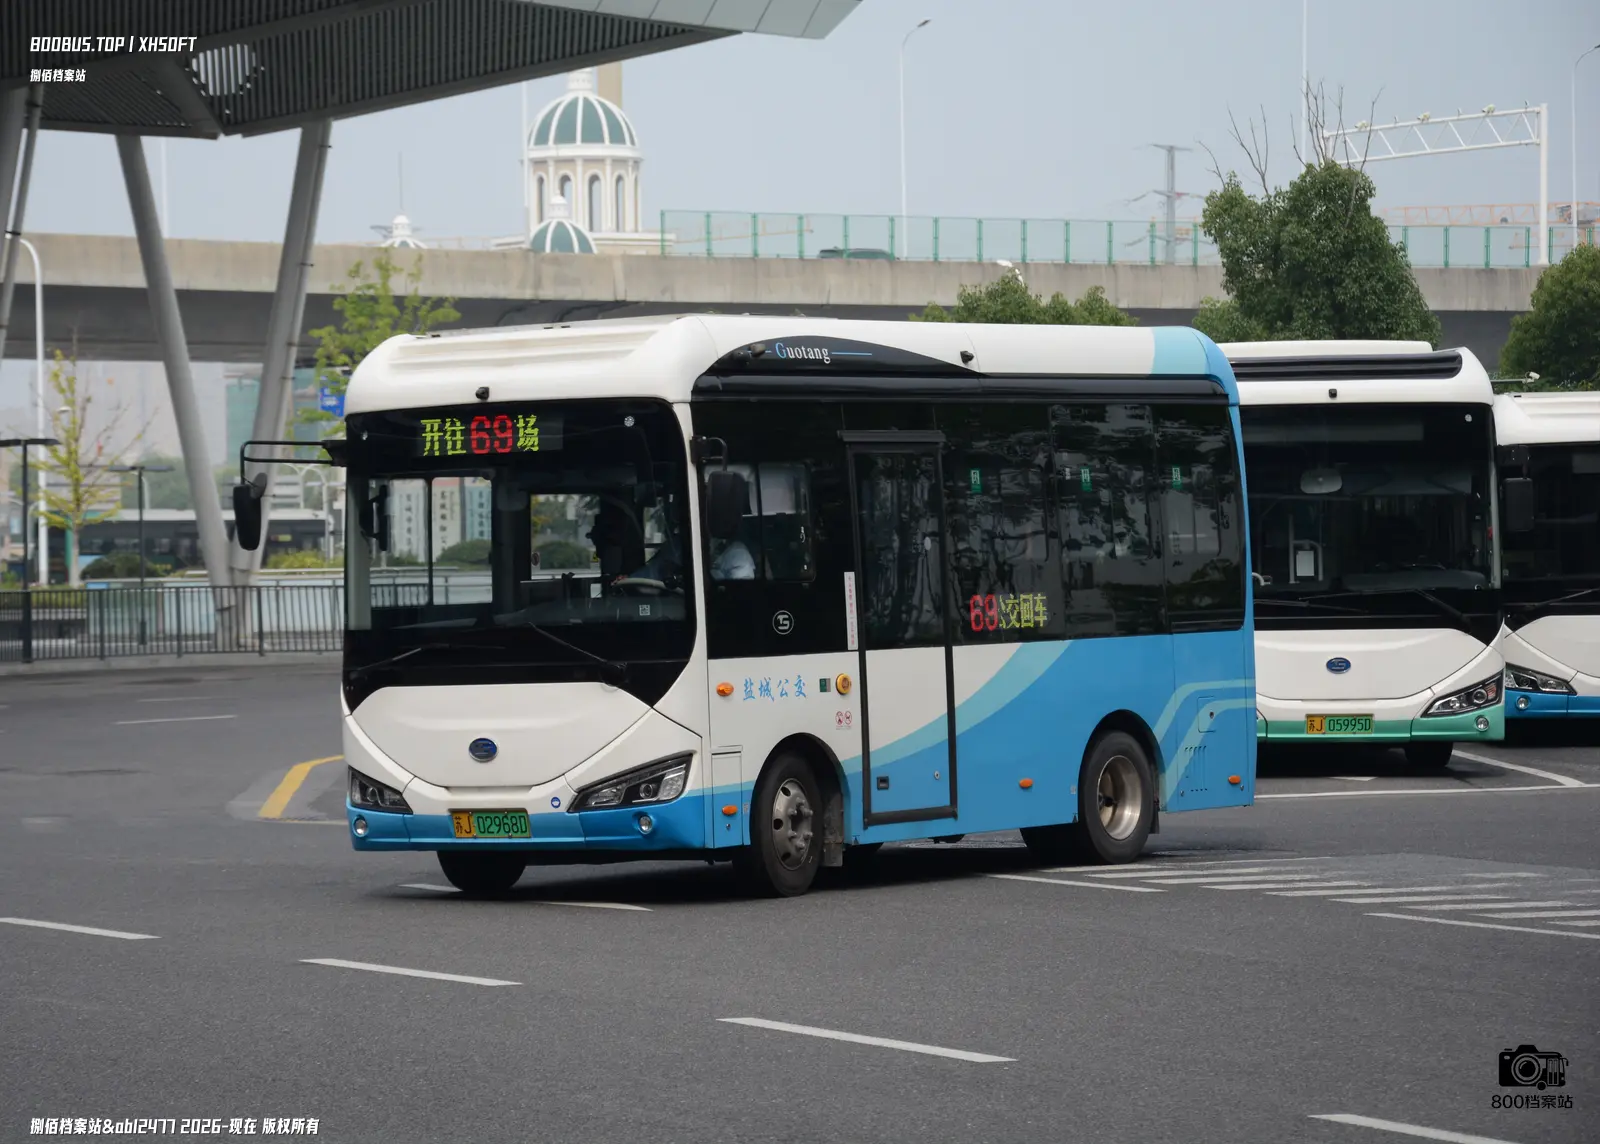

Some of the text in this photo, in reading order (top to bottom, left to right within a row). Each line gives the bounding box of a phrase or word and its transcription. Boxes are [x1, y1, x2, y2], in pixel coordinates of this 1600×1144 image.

[775, 342, 831, 364] Guotang
[743, 675, 807, 701] 盐城公交
